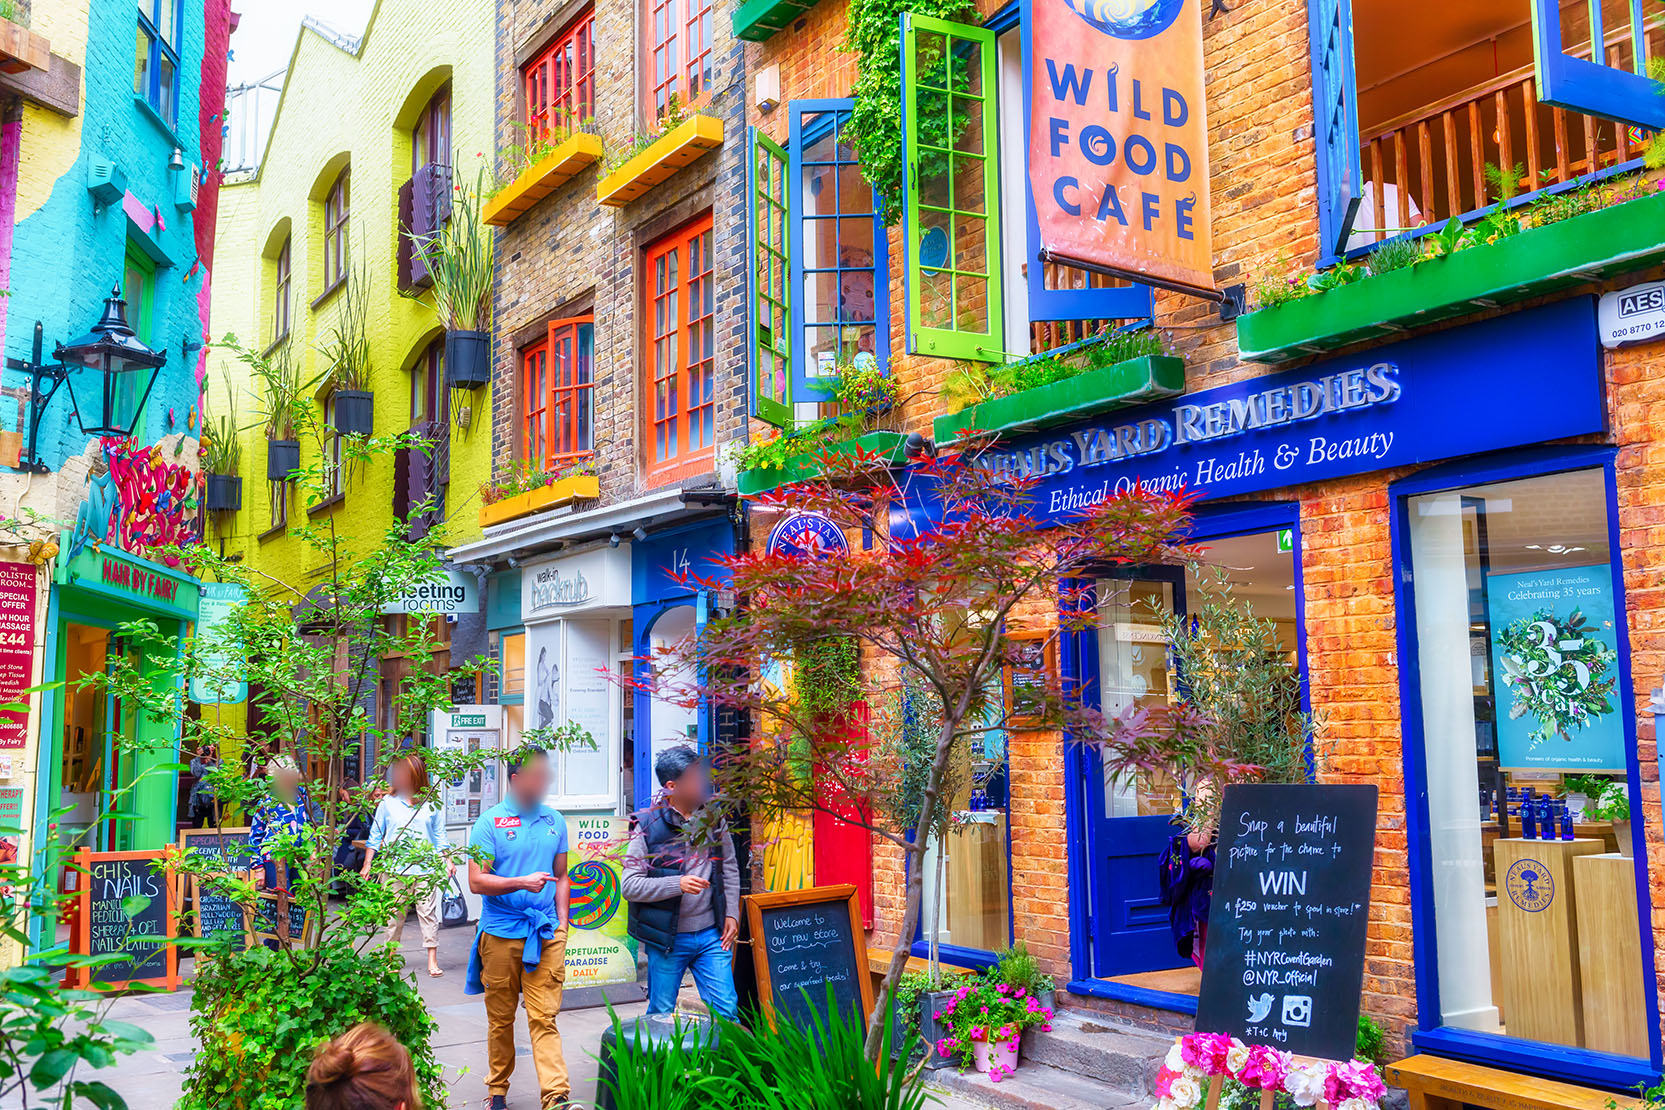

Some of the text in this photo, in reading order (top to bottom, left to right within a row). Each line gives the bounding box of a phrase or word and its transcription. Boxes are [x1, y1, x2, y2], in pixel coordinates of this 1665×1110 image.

[1045, 58, 1189, 127] WILD
[1049, 117, 1192, 183] FOOD
[1623, 291, 1662, 315] AES
[1612, 320, 1665, 338] 020 8770 12
[972, 362, 1398, 485] NEAL'S YARD REMEDIES
[1048, 480, 1108, 513] Ethical
[1193, 449, 1265, 486] Health
[1273, 443, 1299, 470] &
[1305, 431, 1394, 465] Beauty
[777, 518, 814, 552] NEAL'S
[673, 548, 691, 575] 14
[0, 571, 33, 580] OLISTIC
[103, 558, 179, 601] HAIR BY FAIRY
[537, 566, 559, 584] walk-in
[1517, 576, 1590, 588] Neal's Yard Remedies
[395, 583, 465, 602] eeting
[531, 569, 588, 606] backrub
[1508, 587, 1601, 601] Celebrating 35 years
[0, 592, 29, 601] SPECIAL
[1, 601, 26, 609] OFFER
[403, 599, 455, 610] rooms
[0, 622, 31, 631] ASSAGE
[9, 614, 30, 622] HOUR
[0, 632, 26, 646] £44
[3, 687, 25, 695] Massag
[1529, 680, 1588, 721] years
[461, 717, 485, 725] FIRE EXIT
[7, 738, 21, 746] Fairy
[579, 819, 610, 829] WILD
[1237, 811, 1338, 841] Snap a beautiful
[190, 836, 219, 845] SPECIAL
[578, 831, 609, 840] FOOD
[1229, 842, 1342, 868] picture for the chance to
[94, 861, 132, 879] CHI'S
[1510, 863, 1550, 884] NEAL'S YARD
[103, 875, 159, 899] NAILS
[1259, 870, 1307, 896] WIN
[200, 904, 231, 912] BRAZILIAN
[1224, 903, 1230, 911] a
[1235, 898, 1257, 919] £250
[1263, 902, 1288, 911] voucher
[1293, 901, 1301, 916] to
[1305, 903, 1322, 919] spend
[138, 920, 159, 935] OPI
[773, 913, 825, 930] Welcome to
[92, 936, 123, 952] NAILS
[771, 929, 839, 946] our new store
[1238, 927, 1320, 946] Tag your photo with:
[565, 946, 619, 956] RPETUATING
[1244, 950, 1333, 967] #NYRCoventGarden
[565, 957, 608, 967] PARADISE
[777, 962, 799, 973] Come
[801, 961, 807, 970] &
[573, 968, 599, 977] DAILY
[1242, 969, 1318, 986] @NYR_Official
[780, 983, 792, 991] our
[1272, 1028, 1288, 1043] Apply
